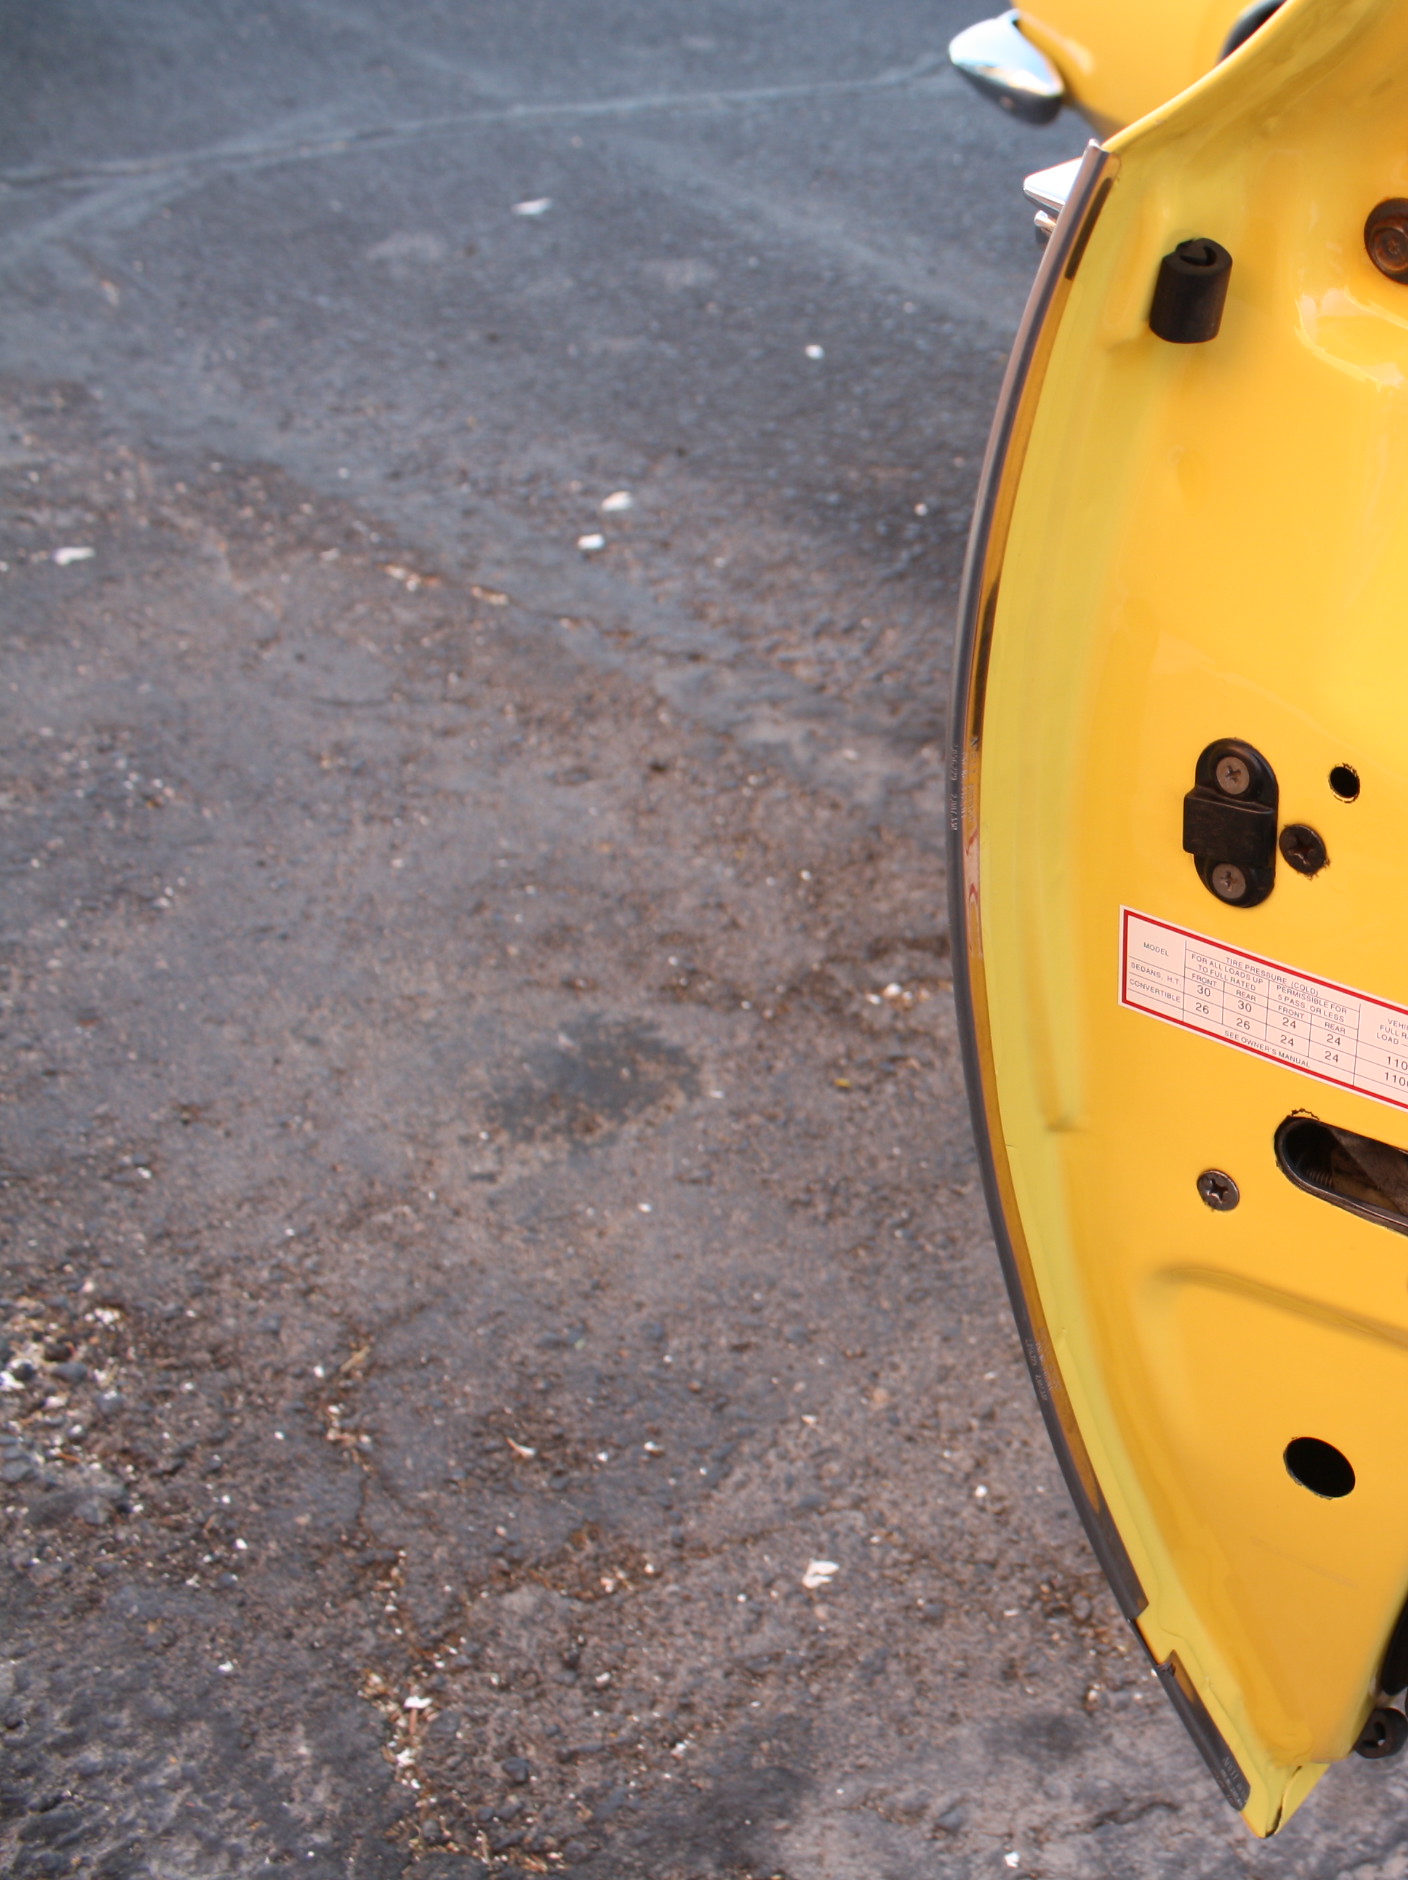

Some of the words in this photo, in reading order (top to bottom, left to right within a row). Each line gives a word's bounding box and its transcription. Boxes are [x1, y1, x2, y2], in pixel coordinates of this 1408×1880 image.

[1143, 941, 1169, 957] MODEL
[1191, 954, 1207, 964] FOR
[1209, 960, 1223, 970] ALL
[1225, 966, 1251, 981] LOADS
[1253, 975, 1263, 985] UP
[1225, 957, 1243, 969] TIRE
[1244, 964, 1287, 985] PRESSURE
[1291, 980, 1319, 996] (COLD)
[1191, 973, 1218, 987] FRONT
[1198, 965, 1208, 974] TO
[1210, 969, 1228, 981] FULL
[1230, 977, 1256, 991] RATED
[1129, 978, 1181, 1003] CONVERTIBLE
[1196, 985, 1211, 997] 30
[1236, 990, 1256, 1002] REAR
[1237, 1000, 1252, 1013] 30
[1276, 984, 1329, 1009] PERMISSIBLE
[1330, 1004, 1347, 1015] FOR
[1195, 1002, 1210, 1015] 26
[1278, 993, 1283, 1001] 5
[1309, 1005, 1322, 1016] OR
[1323, 1010, 1344, 1023] LESS
[1278, 1005, 1305, 1020] FRONT
[1236, 1018, 1250, 1030] 26
[1282, 1016, 1297, 1030] 24
[1324, 1022, 1346, 1034] REAR
[1379, 1025, 1399, 1037] FULL
[1280, 1034, 1294, 1047] 24
[1326, 1033, 1341, 1046] 24
[1376, 1032, 1399, 1046] LOAD
[1224, 1030, 1240, 1041] SEE
[1241, 1036, 1277, 1056] OWNER'S
[1278, 1050, 1311, 1068] MANUAL
[1324, 1050, 1339, 1063] 24
